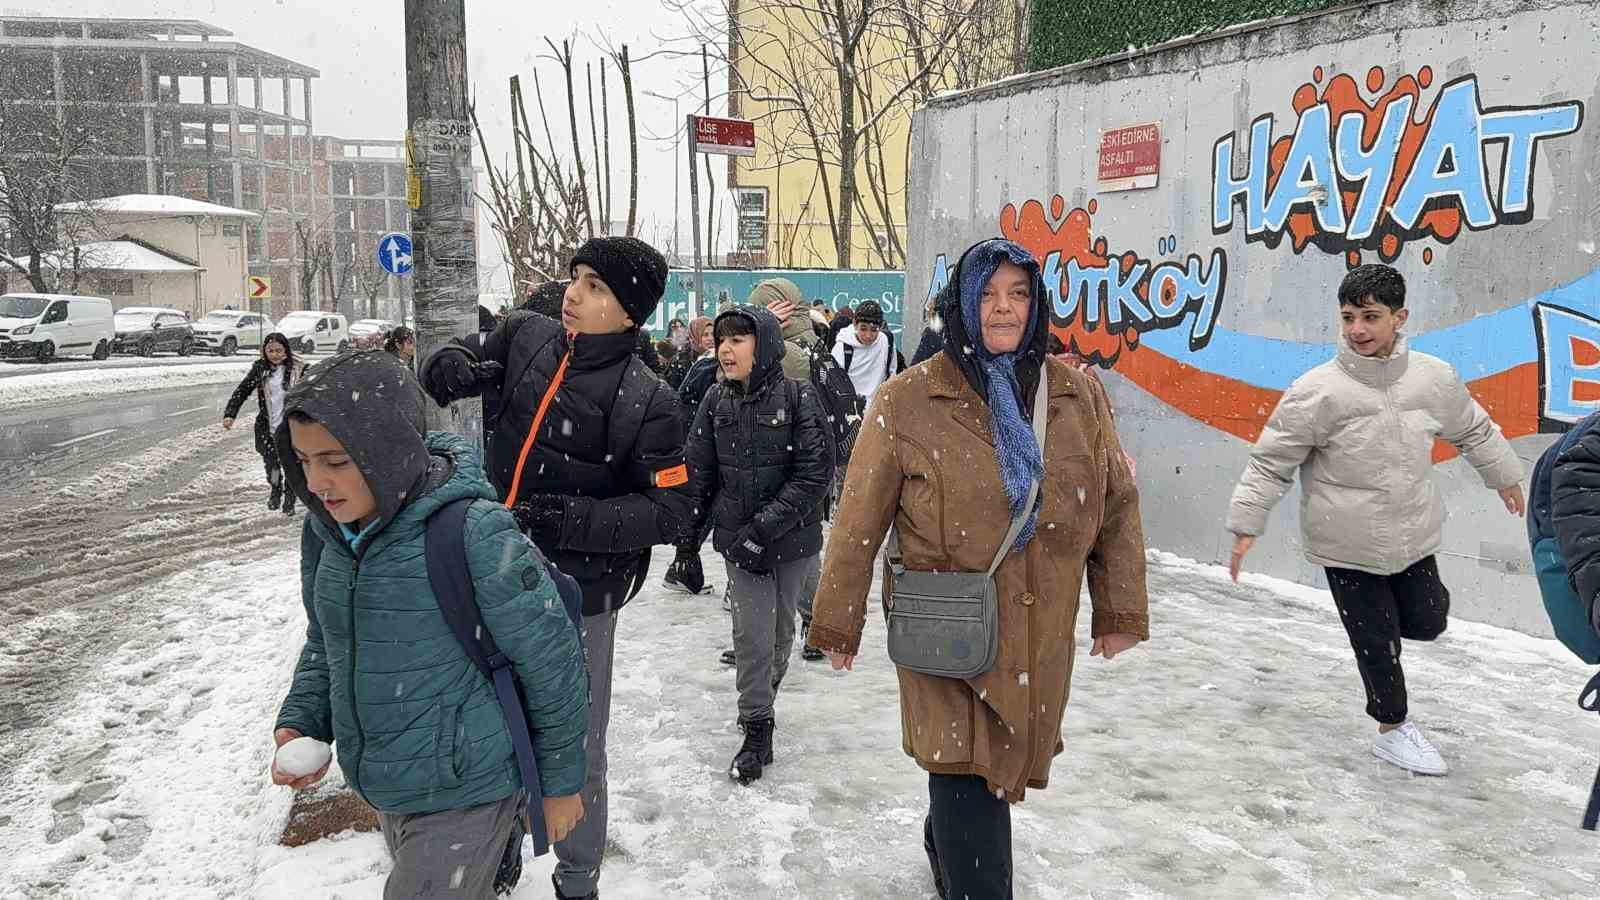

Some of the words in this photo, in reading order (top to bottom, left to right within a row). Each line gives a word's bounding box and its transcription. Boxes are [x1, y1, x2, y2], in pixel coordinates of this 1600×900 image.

[1101, 131, 1120, 148] ESKİ
[1122, 127, 1156, 145] EDİRNE
[1100, 150, 1134, 167] ASFALTI
[1211, 74, 1583, 248] HAYAT
